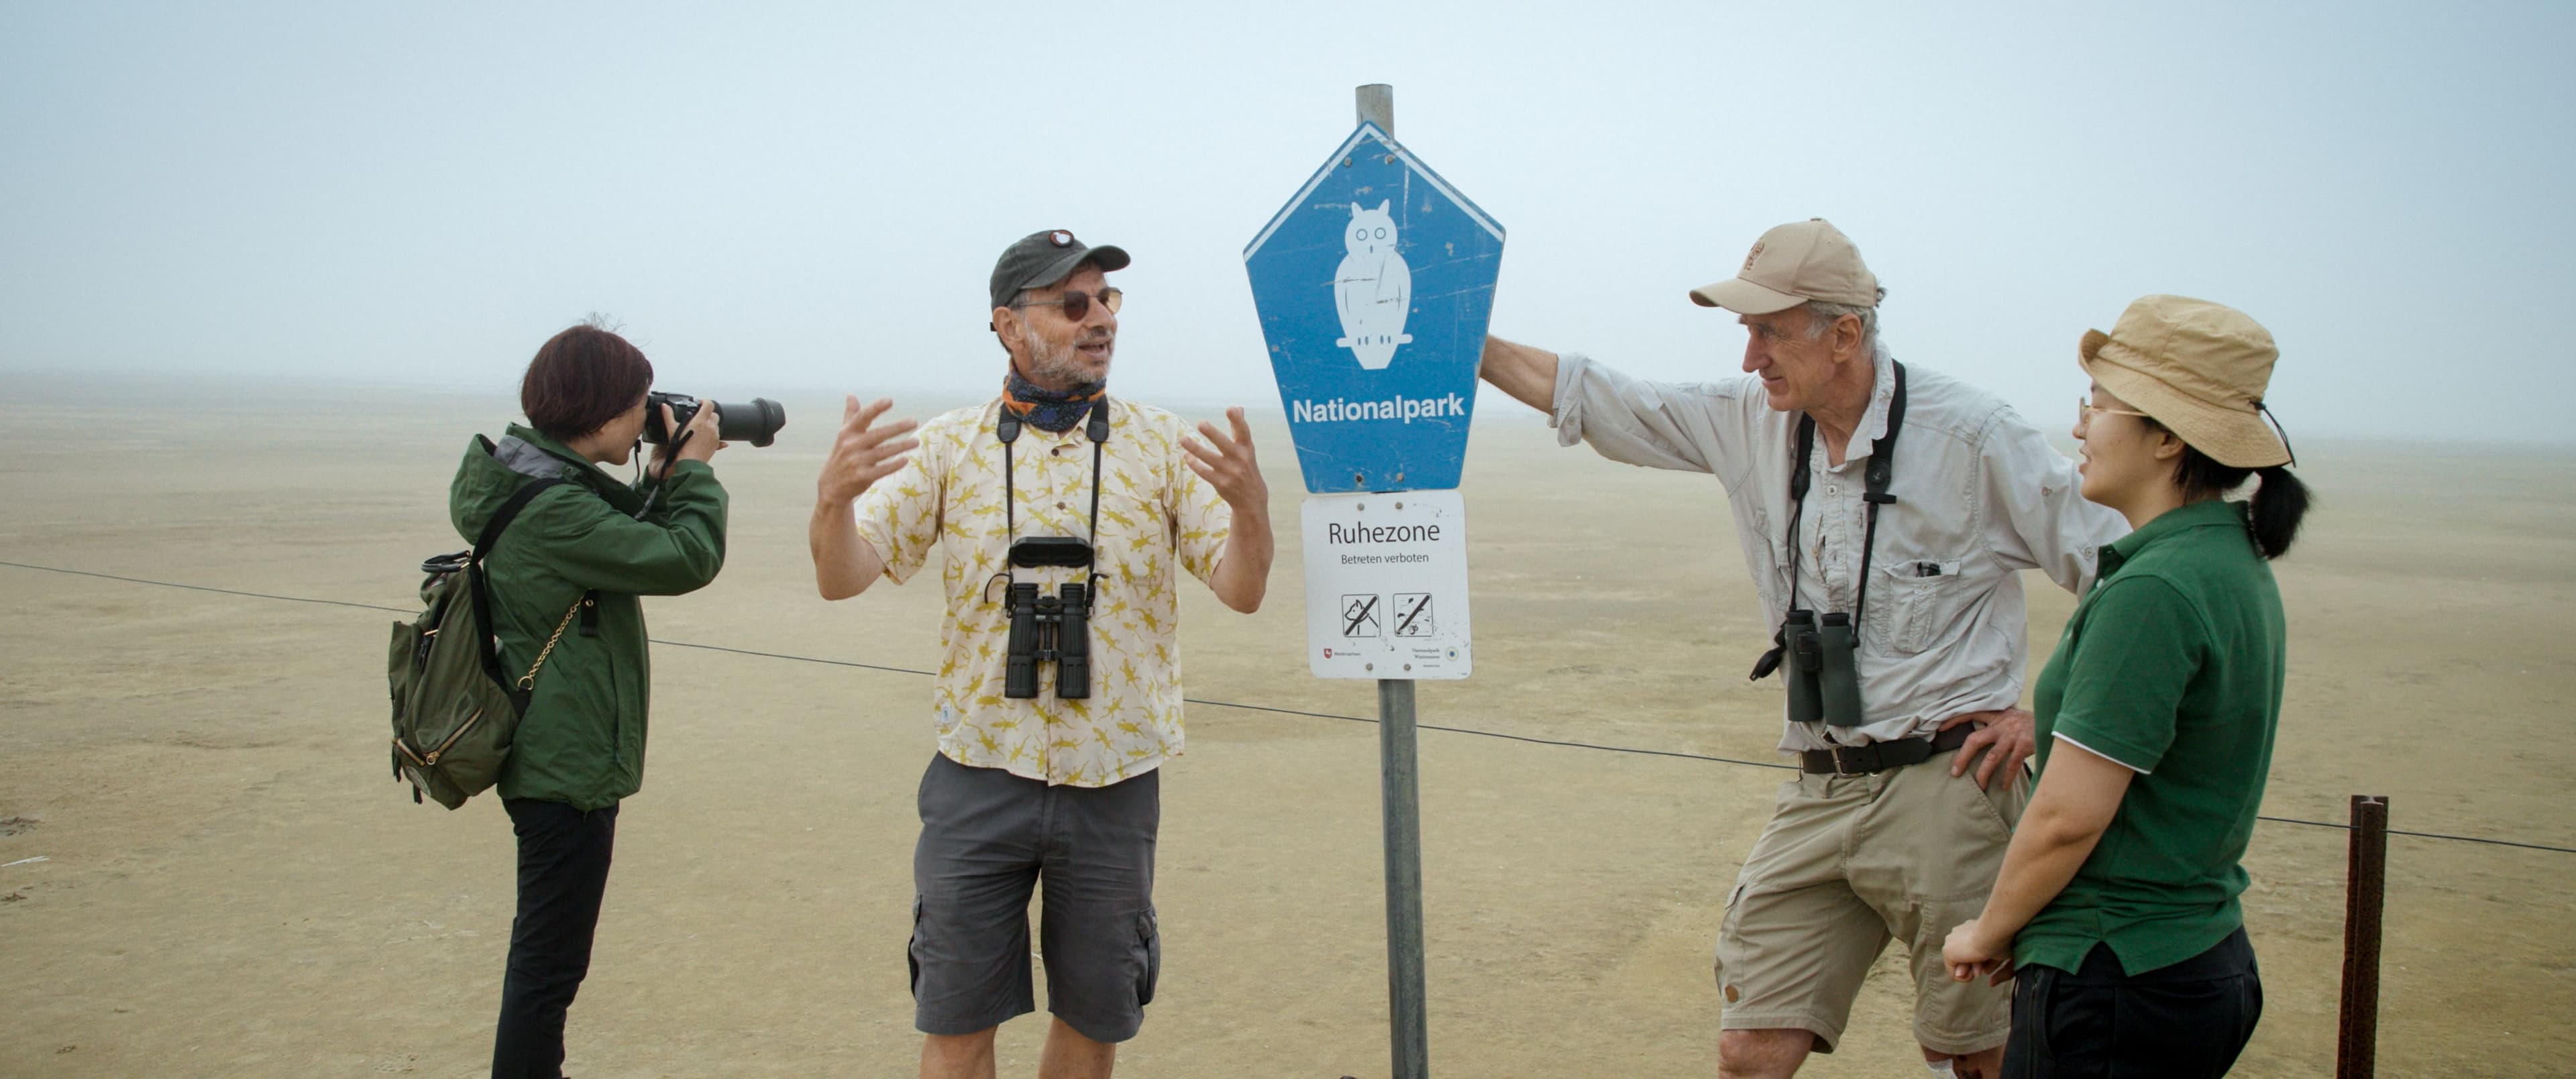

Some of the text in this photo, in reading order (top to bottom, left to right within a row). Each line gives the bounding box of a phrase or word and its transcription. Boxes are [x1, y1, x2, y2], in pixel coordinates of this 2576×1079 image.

[1293, 392, 1465, 424] Nationalpark
[1329, 521, 1440, 545] Ruhezone
[1341, 553, 1429, 565] Betreten verboten
